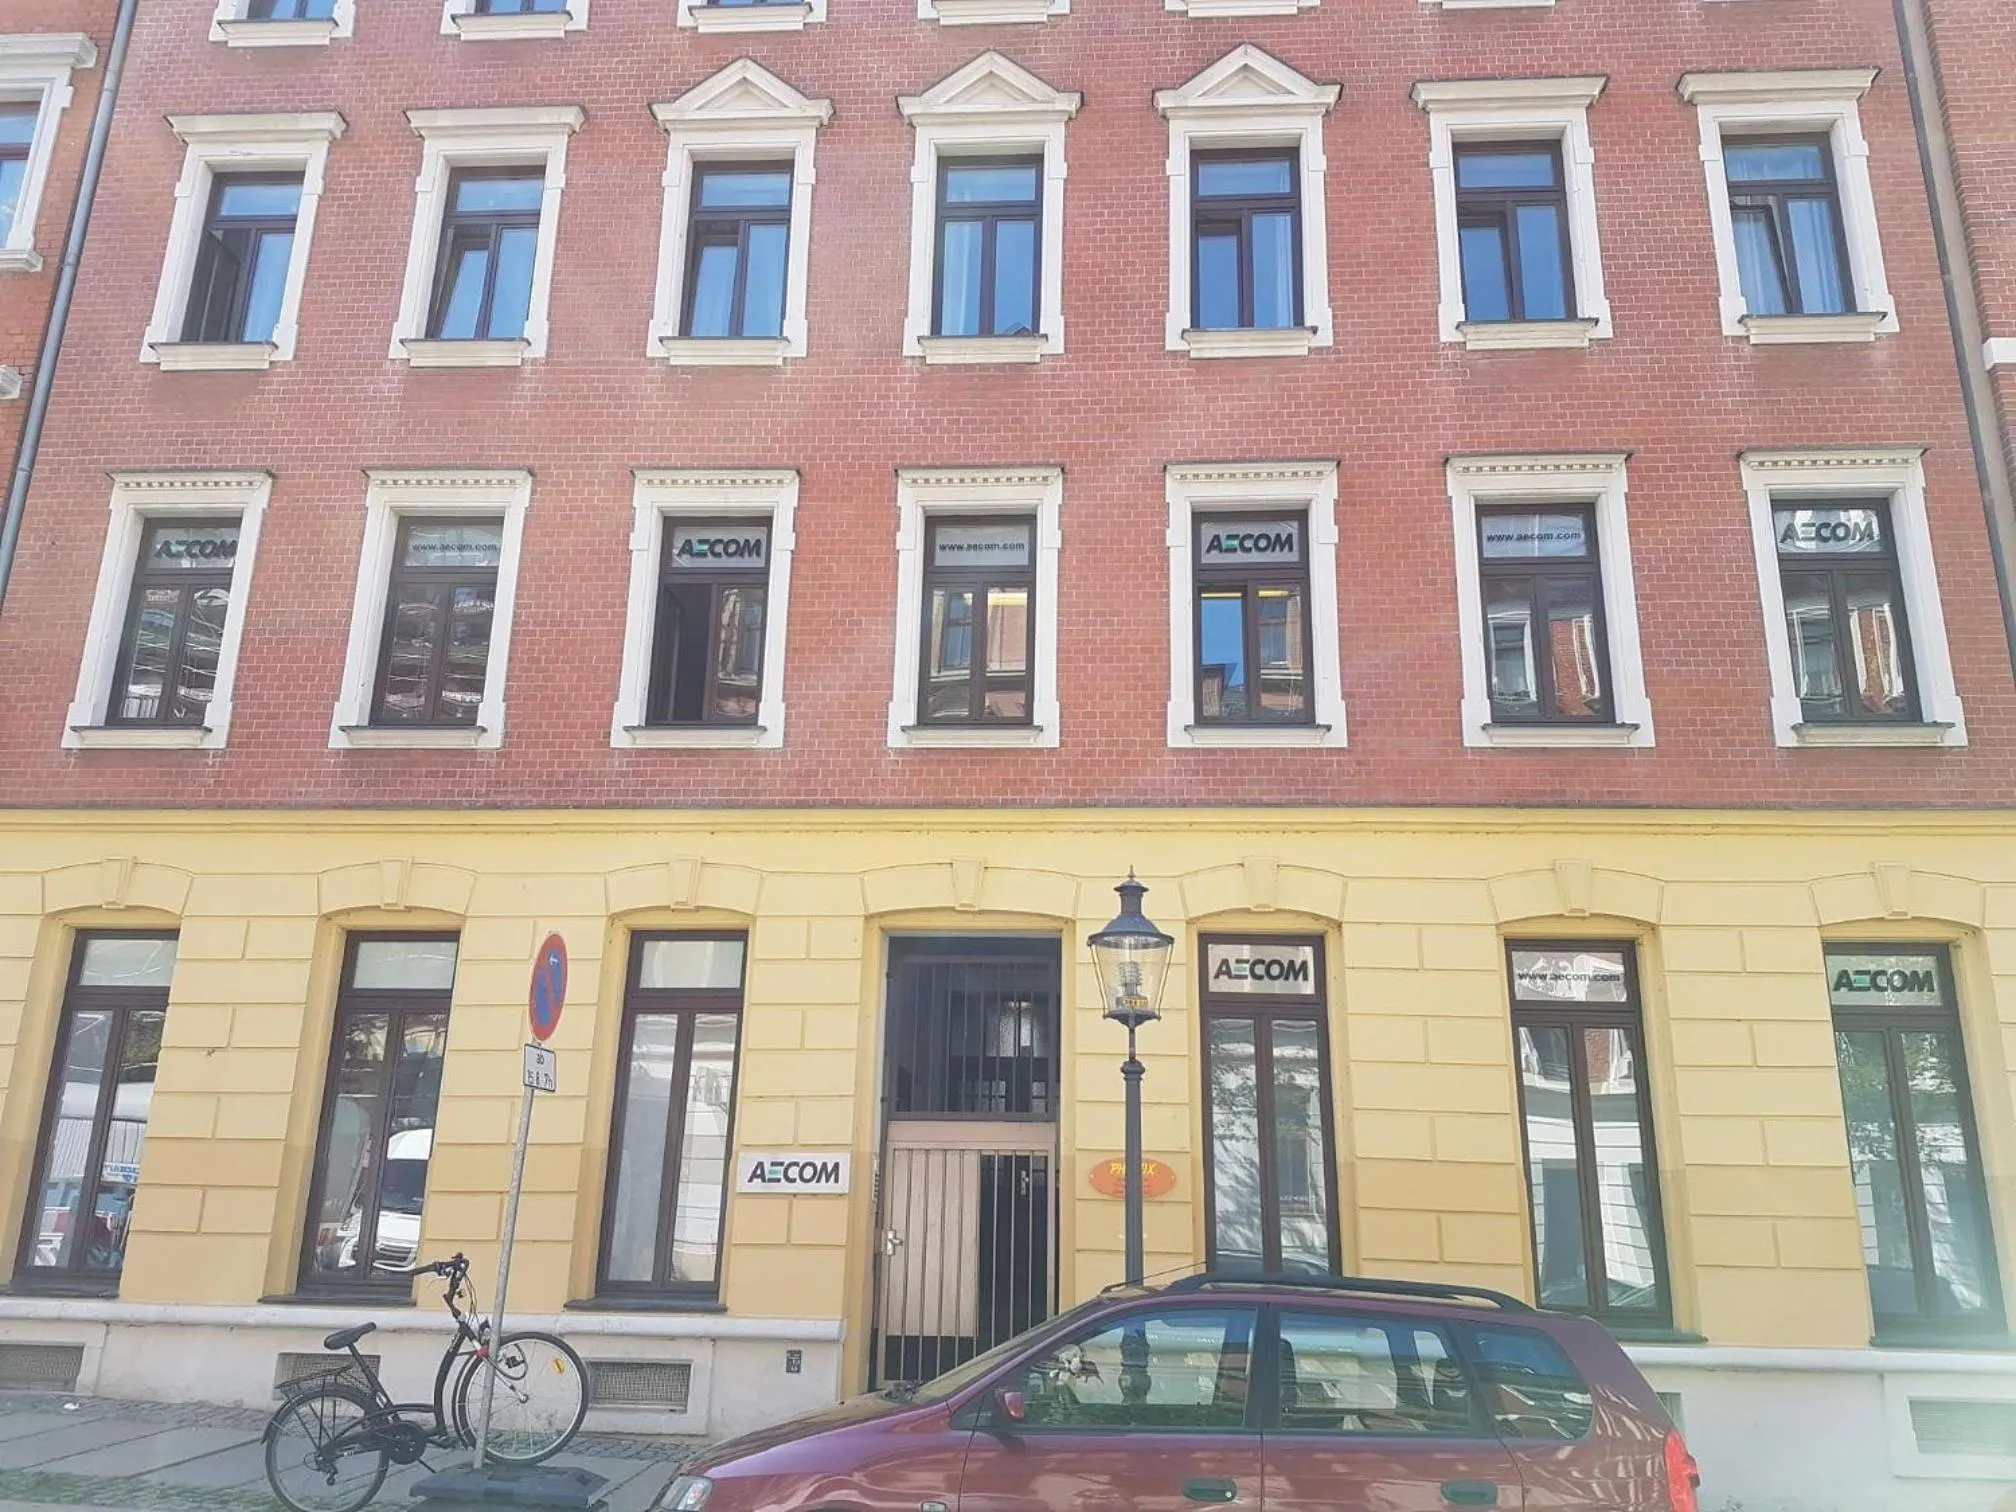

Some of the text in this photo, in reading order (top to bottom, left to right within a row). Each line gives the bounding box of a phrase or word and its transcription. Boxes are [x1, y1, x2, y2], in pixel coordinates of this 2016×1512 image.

[1206, 533, 1294, 553] AECOM
[1486, 532, 1581, 543] www.aecom.com
[1780, 522, 1874, 545] AECOM
[156, 540, 238, 559] AECOM
[411, 542, 499, 552] www.aecom.com
[677, 538, 761, 557] AECOM
[939, 541, 1025, 551] www.aecom.com
[1213, 958, 1309, 982] AECOM
[1518, 970, 1620, 983] www.aecom.com
[1833, 969, 1935, 992] AECOM
[747, 1161, 839, 1184] AECOM
